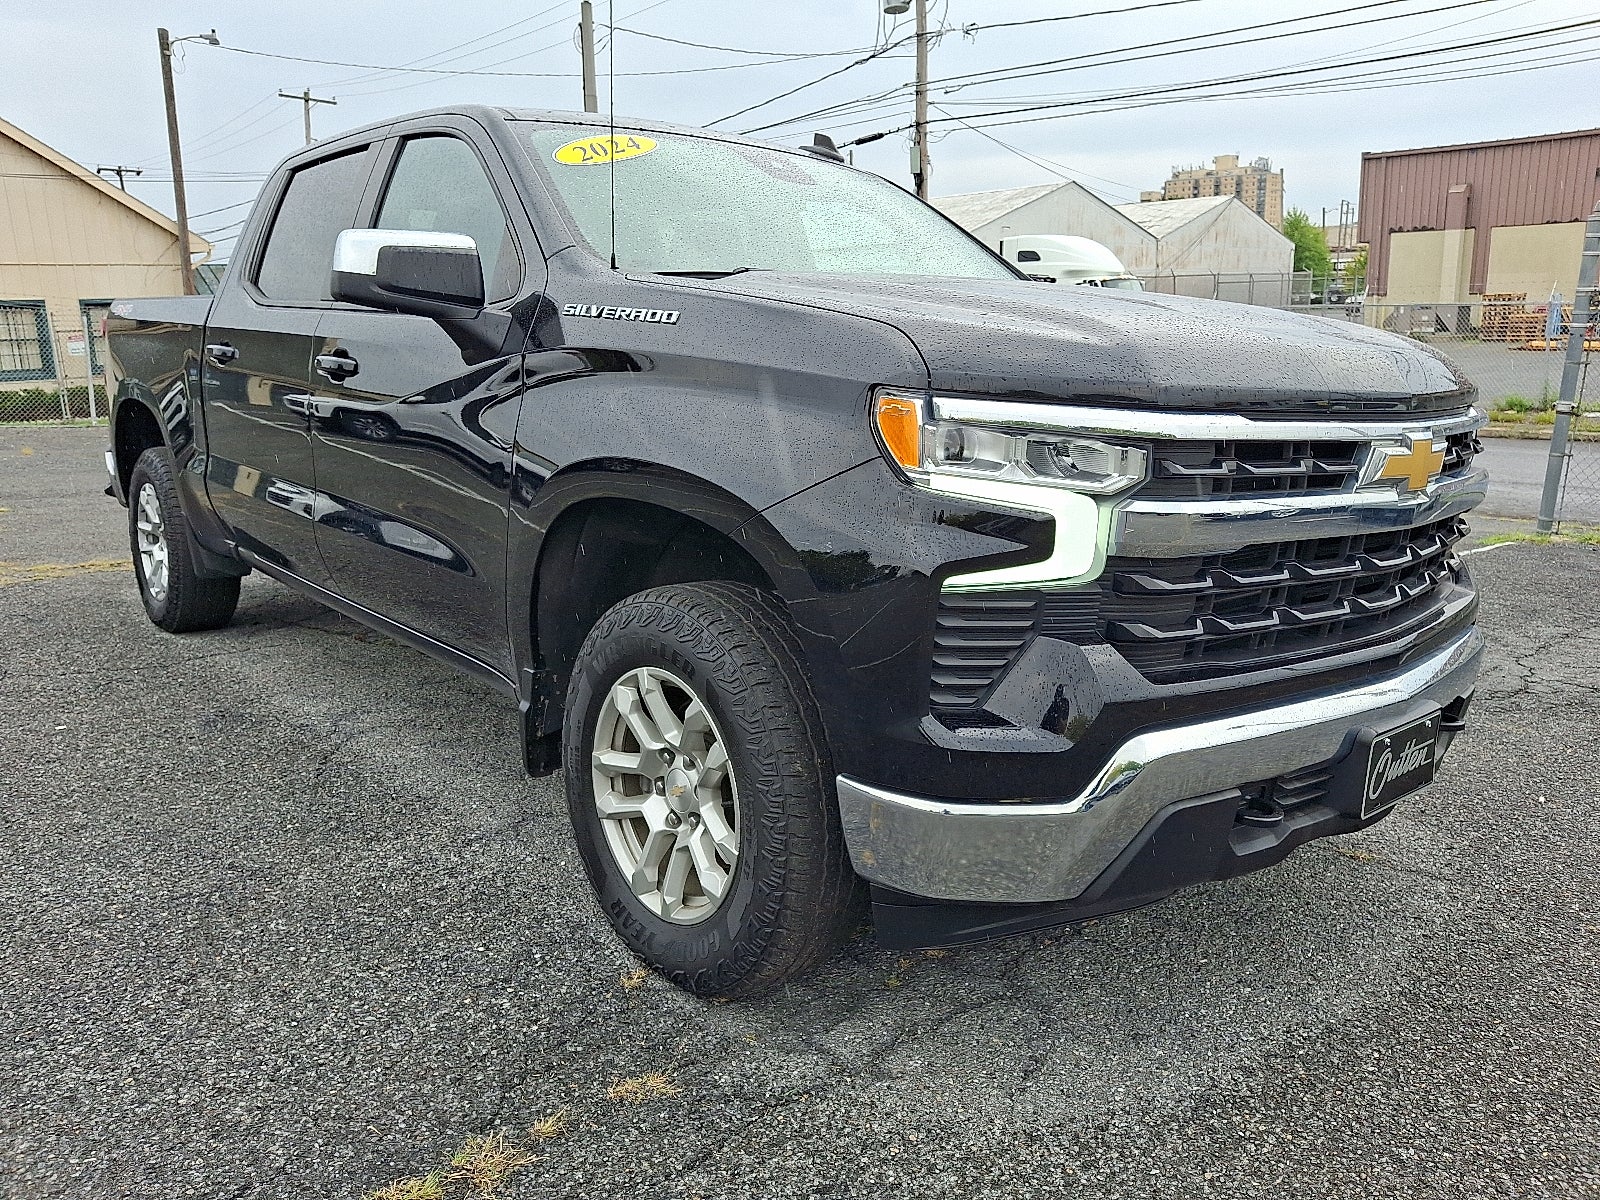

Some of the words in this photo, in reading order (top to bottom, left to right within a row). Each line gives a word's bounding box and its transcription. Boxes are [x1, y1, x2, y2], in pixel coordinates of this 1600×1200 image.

[572, 136, 641, 162] 2024
[562, 303, 681, 325] SILVERADO
[1368, 738, 1435, 800] Outten
